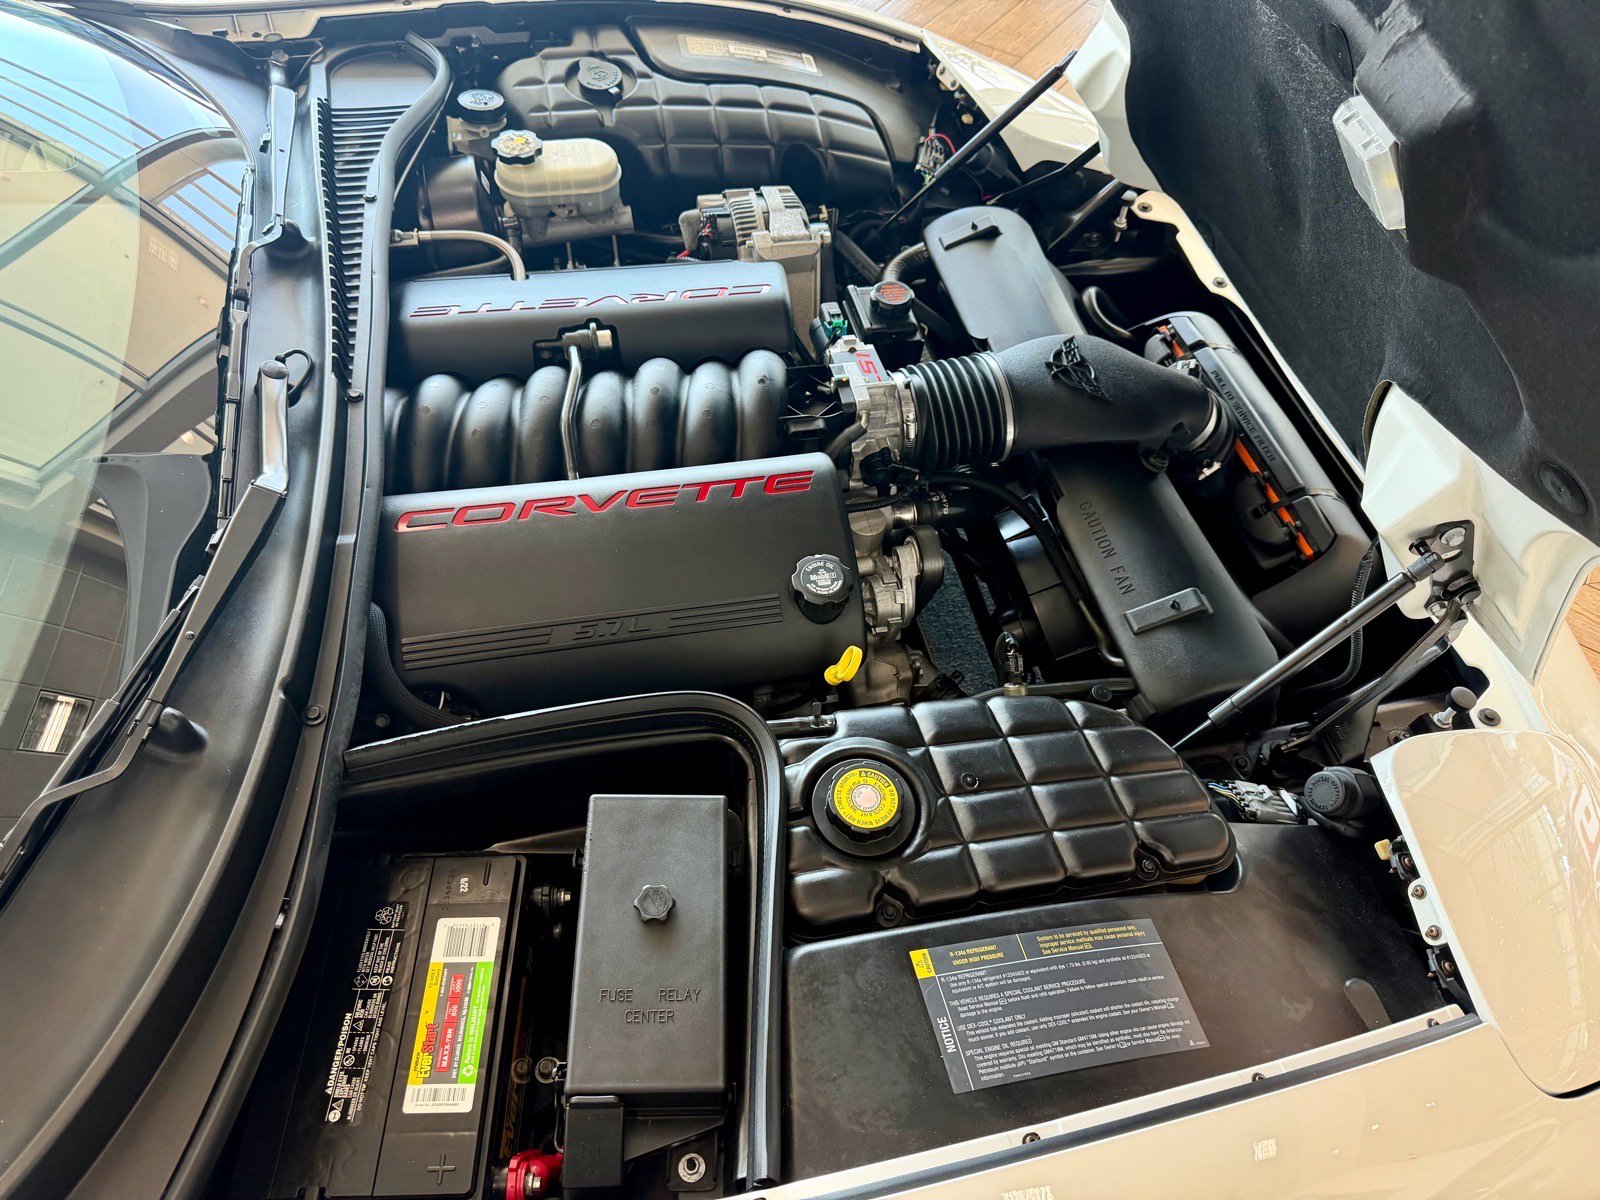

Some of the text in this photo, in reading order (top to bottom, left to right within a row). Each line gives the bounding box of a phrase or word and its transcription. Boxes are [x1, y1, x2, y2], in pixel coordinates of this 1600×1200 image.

[408, 283, 772, 318] CORVETTE
[1211, 370, 1277, 462] PULL TO SERVICE FILTER
[394, 469, 815, 533] CORVETTE
[1079, 500, 1136, 595] CAUTION FAN
[825, 562, 835, 570] OIL
[572, 615, 652, 642] 5.7L
[839, 772, 855, 789] REMOVE
[867, 772, 890, 787] CAUTION
[845, 813, 856, 822] HOT
[860, 803, 886, 817] COOLANT
[875, 809, 894, 825] REMOVE
[1089, 927, 1107, 935] qualified
[966, 944, 997, 954] REFRIGERANT
[980, 952, 1004, 960] PRESSURE
[922, 952, 932, 973] CAUTION
[433, 968, 441, 985] Battery
[957, 970, 987, 979] REFRIGERANT
[599, 988, 702, 1002] FUSE RELAY
[951, 985, 972, 994] equivalent
[959, 996, 978, 1004] VEHICLE
[978, 992, 1000, 1001] REQUIRES
[1022, 985, 1043, 993] COOLANT
[1043, 982, 1061, 990] SERVICE
[1060, 978, 1086, 987] PROCEDURE
[624, 1010, 675, 1024] CENTER
[992, 1015, 1014, 1024] COOLANT
[464, 1043, 472, 1063] Return
[469, 1005, 478, 1034] WALMART
[937, 1016, 956, 1053] NOTICE
[327, 1013, 352, 1086] DANGER/POISON
[357, 1036, 365, 1051] FLAMES
[362, 1034, 371, 1051] SMOKING
[415, 1023, 439, 1077] EverStart
[965, 1048, 984, 1056] SPECIAL
[984, 1044, 1001, 1052] ENGINE
[1009, 1038, 1033, 1047] REQUIRED
[356, 1102, 362, 1110] DO
